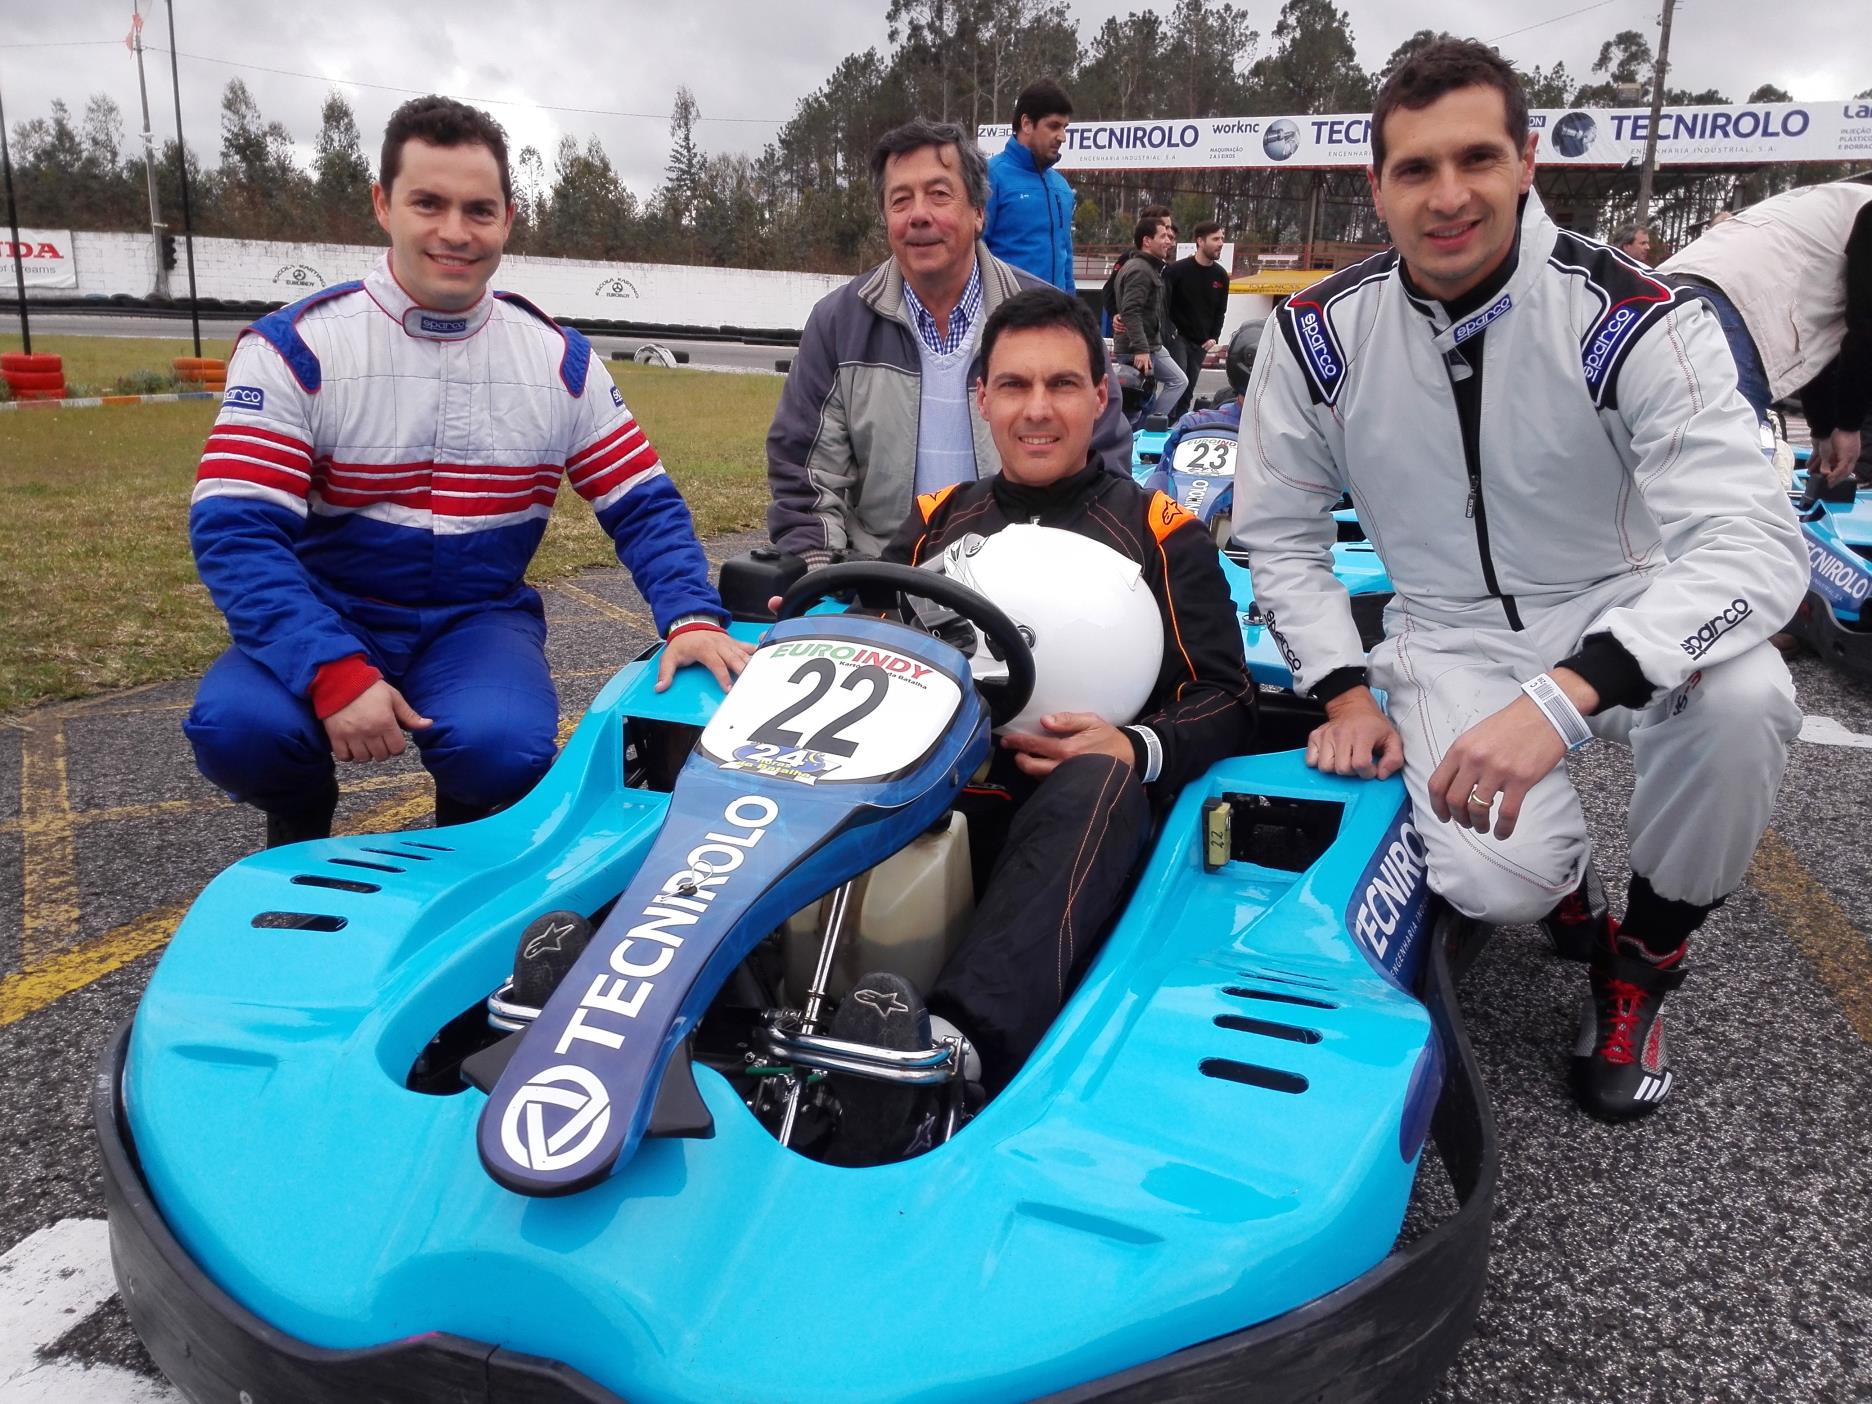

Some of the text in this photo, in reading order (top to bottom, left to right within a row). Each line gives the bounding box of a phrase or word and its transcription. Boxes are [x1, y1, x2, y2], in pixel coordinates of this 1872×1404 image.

[1065, 124, 1200, 150] TECNIROLO
[1212, 120, 1260, 134] worknc
[1610, 109, 1810, 141] TECNIROLO
[1328, 150, 1373, 158] ENGENHARI
[0, 241, 64, 259] DA
[422, 318, 465, 331] sparco
[1455, 297, 1511, 340] sparco
[1300, 312, 1337, 379] sparco
[1583, 308, 1635, 382] sparco
[226, 388, 262, 404] arco
[1186, 442, 1229, 470] 23
[1679, 598, 1752, 661] sparco
[770, 642, 934, 680] EUROINDY
[898, 675, 928, 690] Batalha
[747, 657, 890, 758] 22
[744, 743, 810, 768] 24
[1355, 820, 1429, 960] TECNIRO
[554, 795, 780, 1055] TECNIROLO
